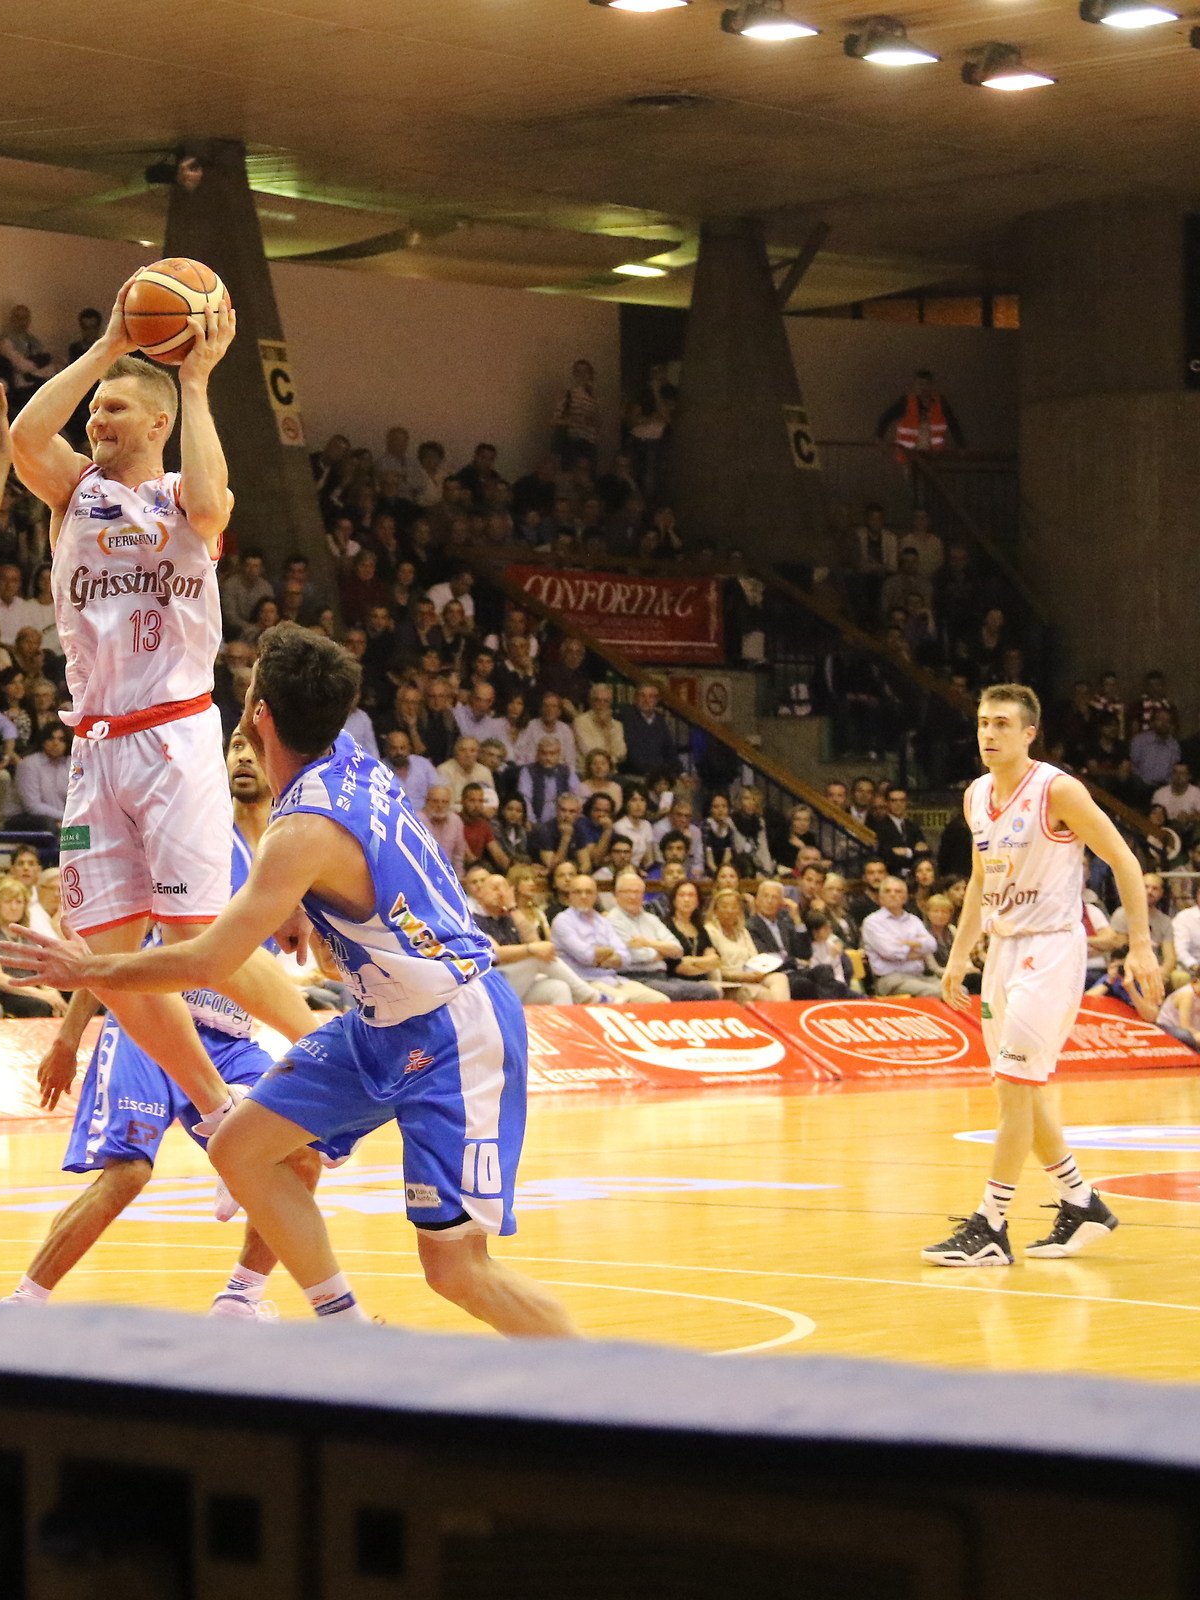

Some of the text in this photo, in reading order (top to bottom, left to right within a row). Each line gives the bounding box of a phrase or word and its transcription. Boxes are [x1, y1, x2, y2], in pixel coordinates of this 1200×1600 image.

[270, 368, 294, 405] C
[793, 429, 815, 464] C
[129, 609, 162, 653] 13
[156, 882, 188, 894] Emak
[584, 1005, 757, 1052] Niagara
[460, 1142, 503, 1194] 10
